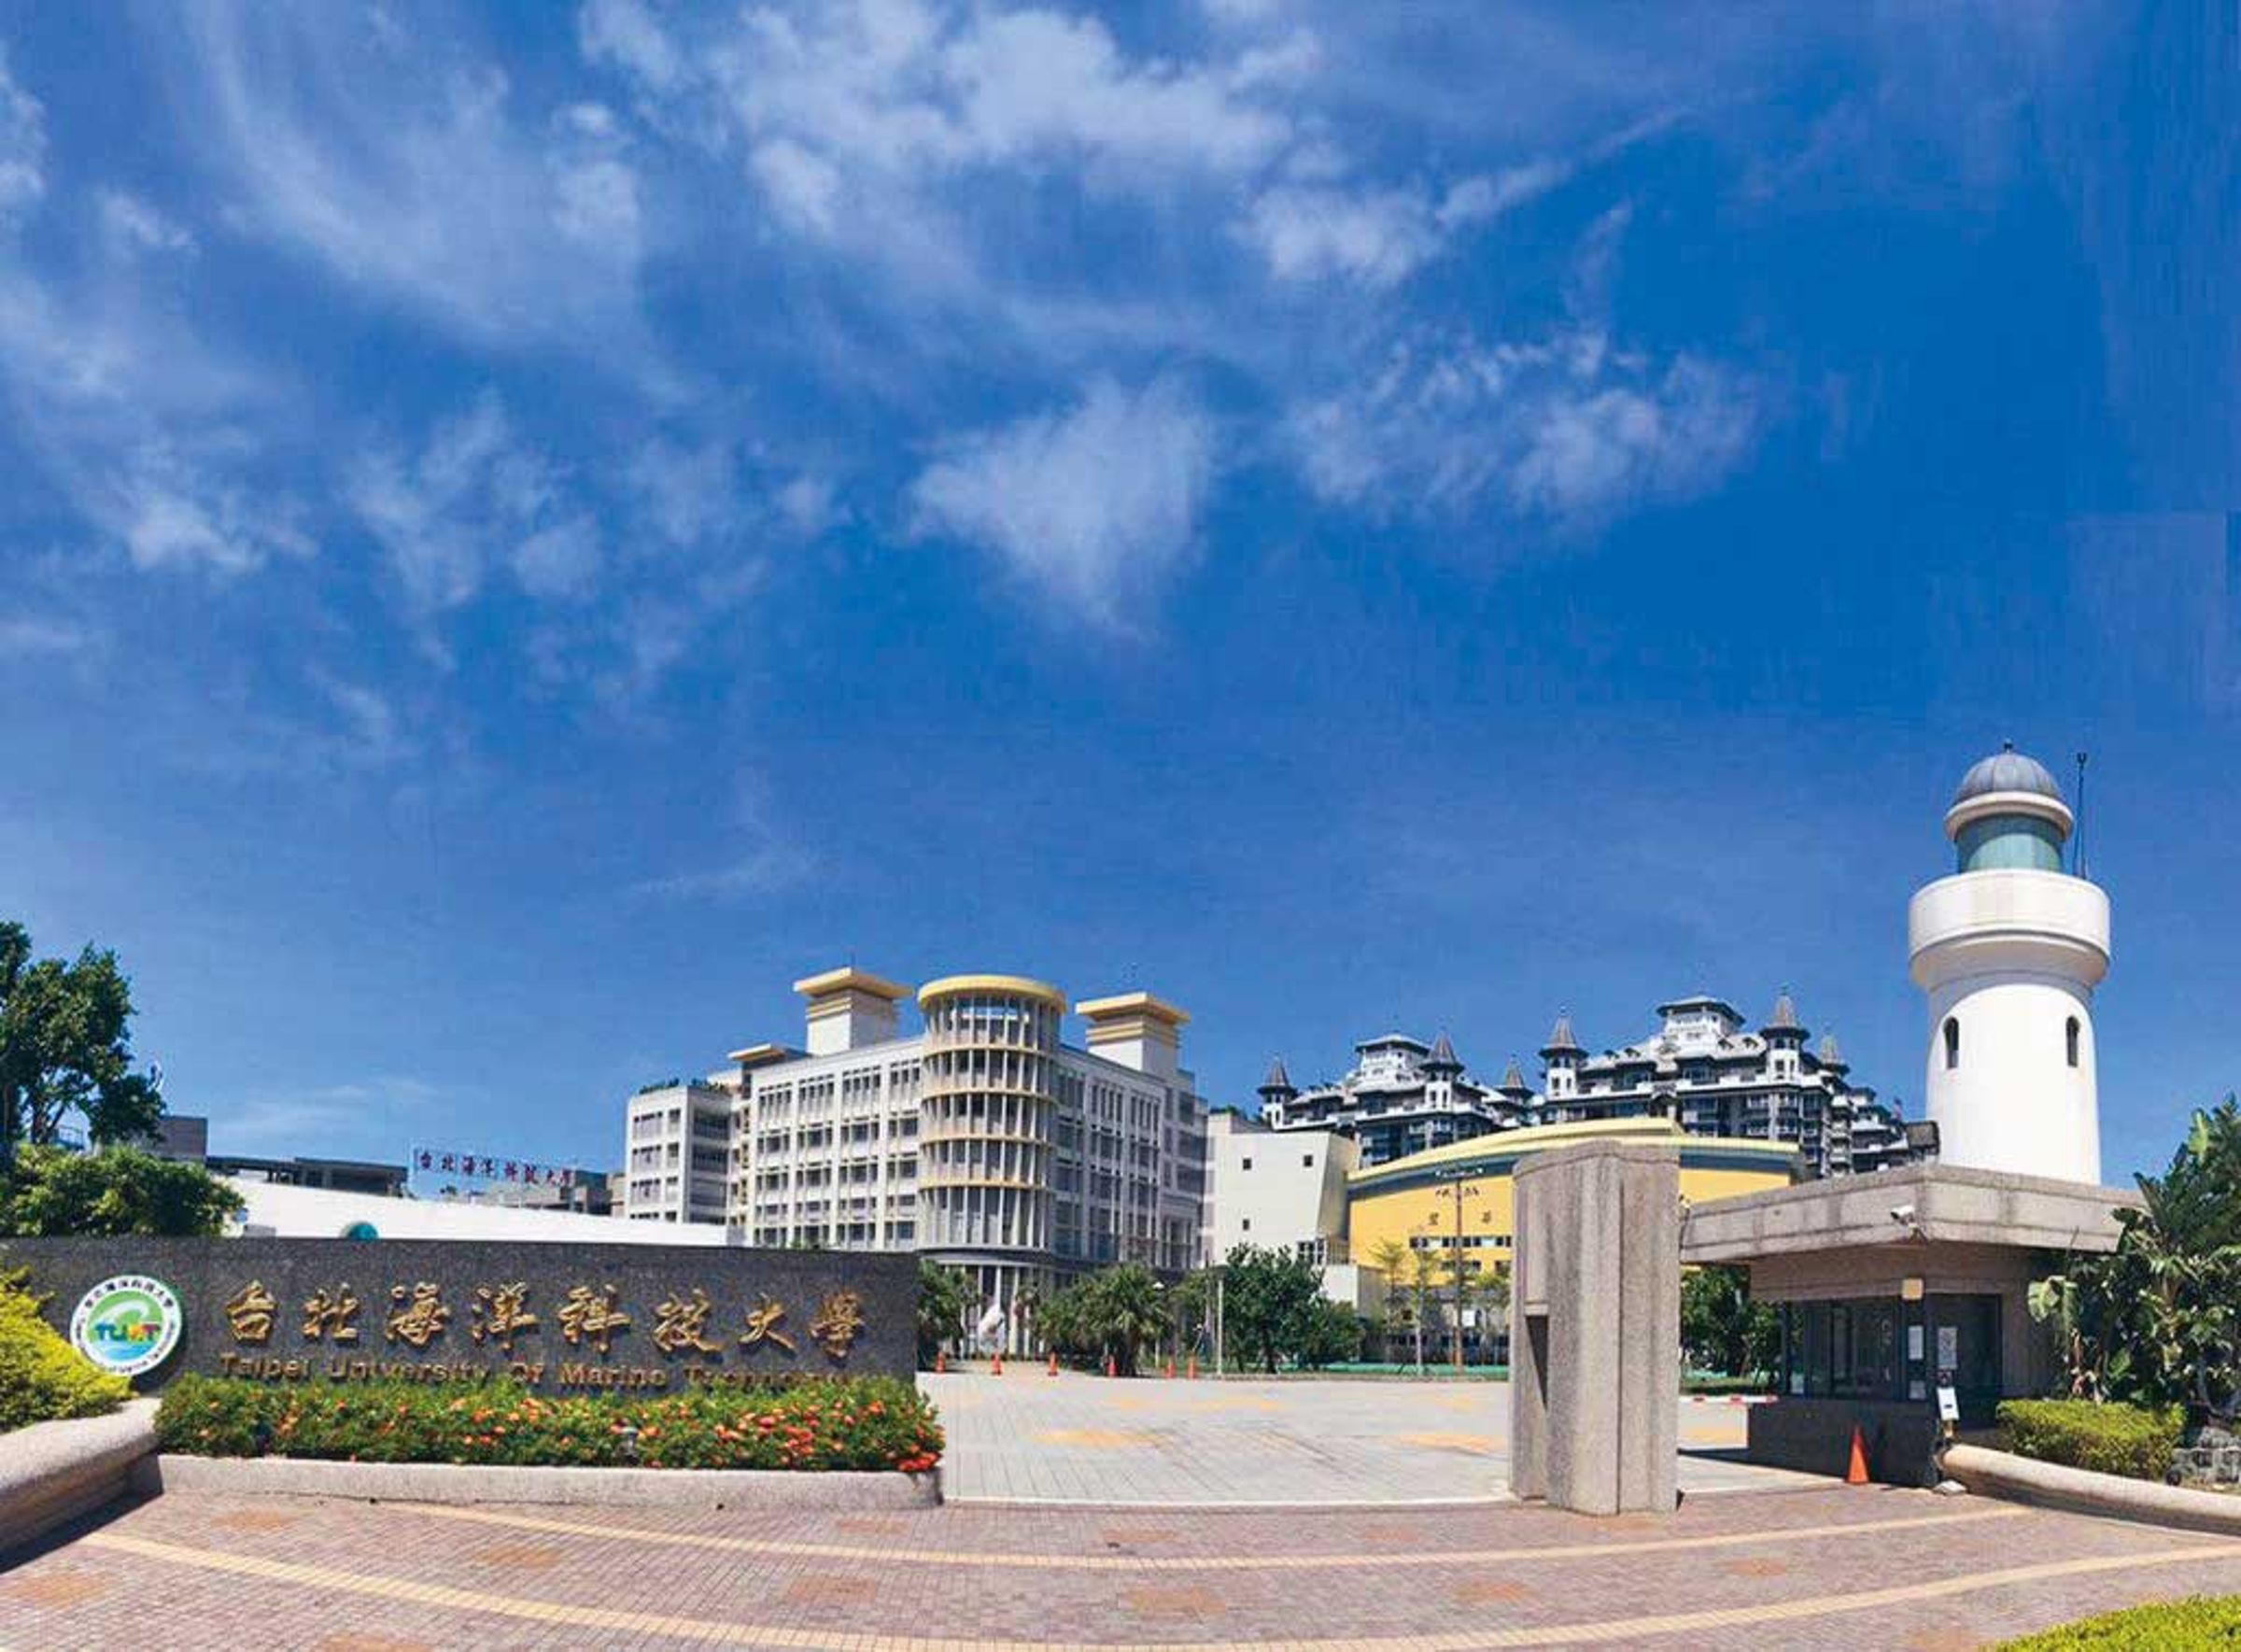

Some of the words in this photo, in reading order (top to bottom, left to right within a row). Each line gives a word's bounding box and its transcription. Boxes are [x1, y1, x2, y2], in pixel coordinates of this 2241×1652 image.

[226, 1279, 867, 1358] 台北海洋科技大學
[218, 1352, 311, 1378] Taipei
[324, 1354, 490, 1385] University
[557, 1363, 667, 1386] Marine
